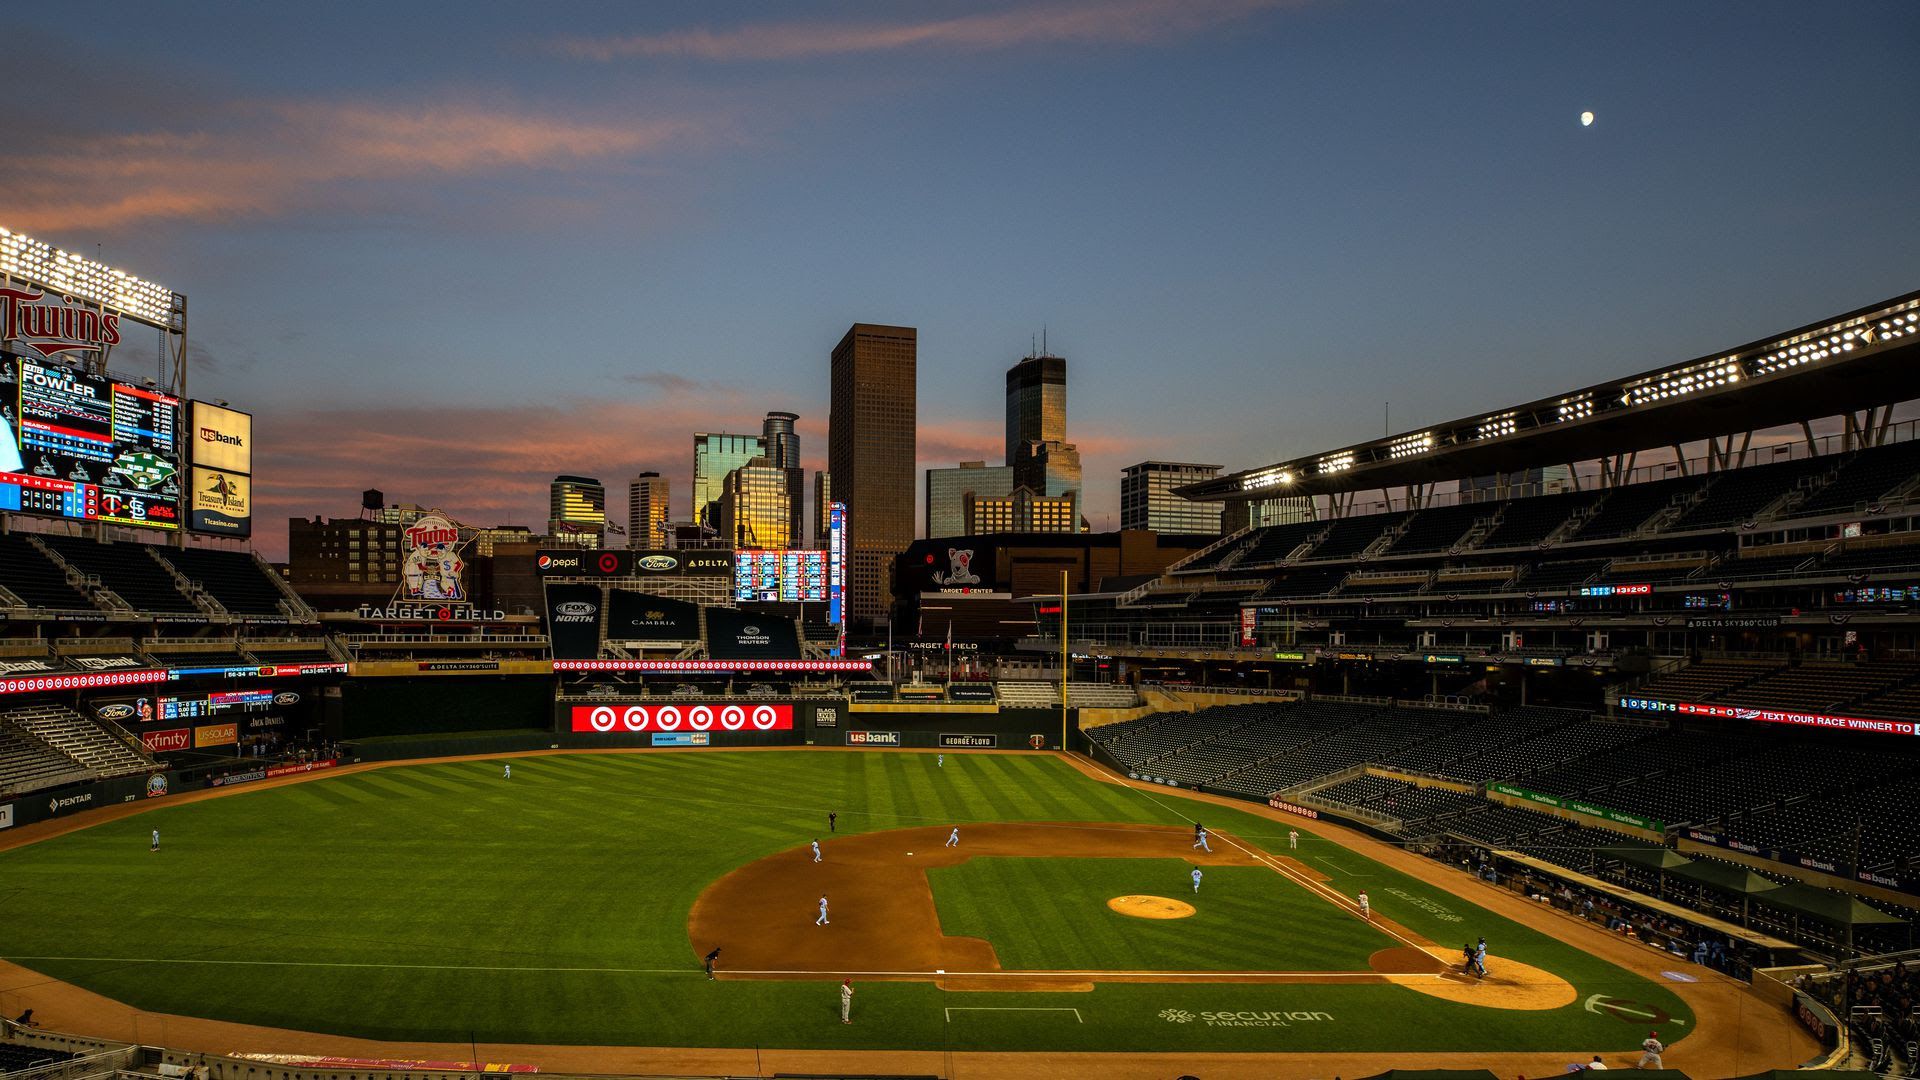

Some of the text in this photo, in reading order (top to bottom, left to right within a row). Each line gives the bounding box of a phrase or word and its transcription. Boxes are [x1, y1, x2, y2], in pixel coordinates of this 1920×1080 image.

[0, 288, 120, 346] Twins
[22, 370, 96, 398] FOWLER
[22, 422, 50, 431] SEASON
[198, 492, 244, 508] Treasure Island
[406, 526, 458, 548] Twins
[552, 557, 578, 568] pepsi
[646, 557, 670, 569] Ford
[565, 604, 587, 612] FOX
[360, 608, 506, 621] TARGET FIELD
[555, 615, 594, 623] NORTH
[260, 668, 274, 676] 72
[938, 672, 990, 682] TWNS
[278, 694, 295, 705] Ford
[104, 708, 128, 718] Ford
[250, 717, 264, 728] JACK
[1762, 712, 1786, 720] TEXT
[1787, 714, 1815, 724] YOUR
[1817, 718, 1846, 727] RACE
[1848, 720, 1892, 732] WINNER
[1895, 723, 1912, 733] TO
[146, 734, 188, 750] xfinity
[224, 772, 252, 784] COMMUNITY
[252, 770, 266, 780] FUND
[268, 768, 285, 776] GETTING
[60, 794, 92, 807] PENTAIR
[1200, 1011, 1335, 1022] securian
